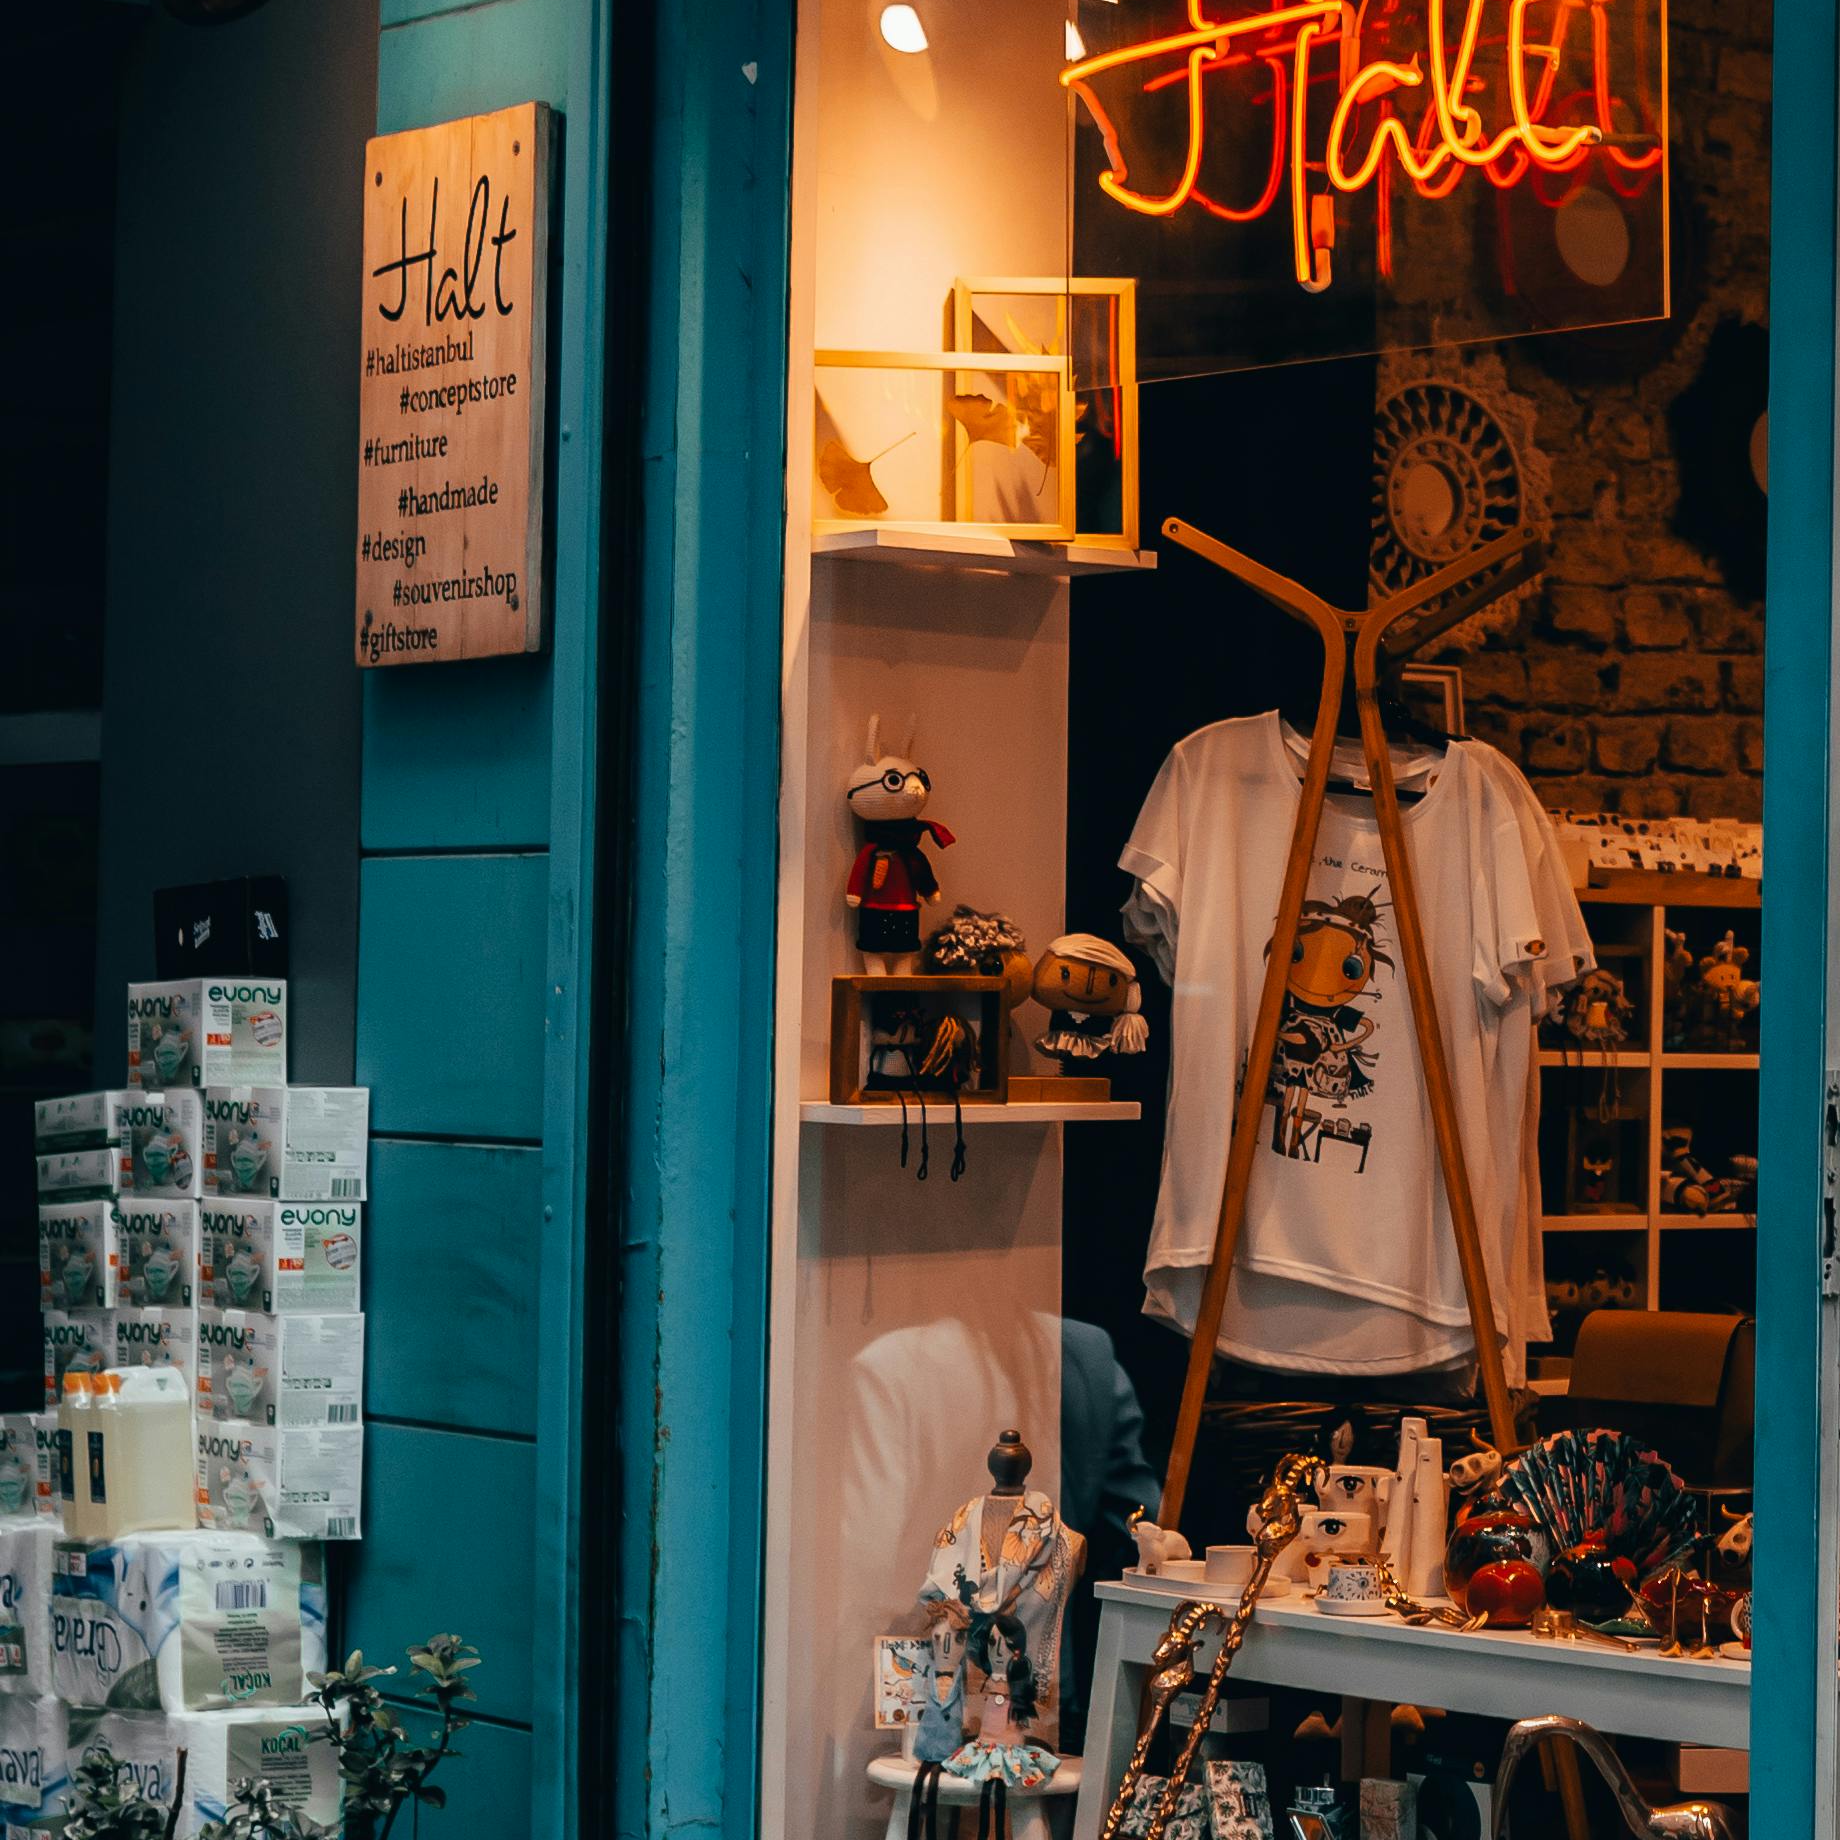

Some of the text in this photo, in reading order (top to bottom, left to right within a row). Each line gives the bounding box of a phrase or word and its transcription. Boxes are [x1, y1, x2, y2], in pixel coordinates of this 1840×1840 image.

[373, 175, 517, 326] Halt
[366, 330, 474, 377] #haltistanbul
[400, 373, 517, 415] #conceptstore
[364, 432, 448, 467] #furniture
[398, 476, 498, 518] #handmade
[362, 530, 426, 569] #design
[393, 565, 517, 607] #souvenirshop
[360, 622, 438, 664] #giftstore
[128, 995, 172, 1019] evony
[208, 985, 282, 1005] evony
[281, 1208, 356, 1227] evony
[117, 1321, 162, 1346] evony
[199, 1322, 246, 1349] evony
